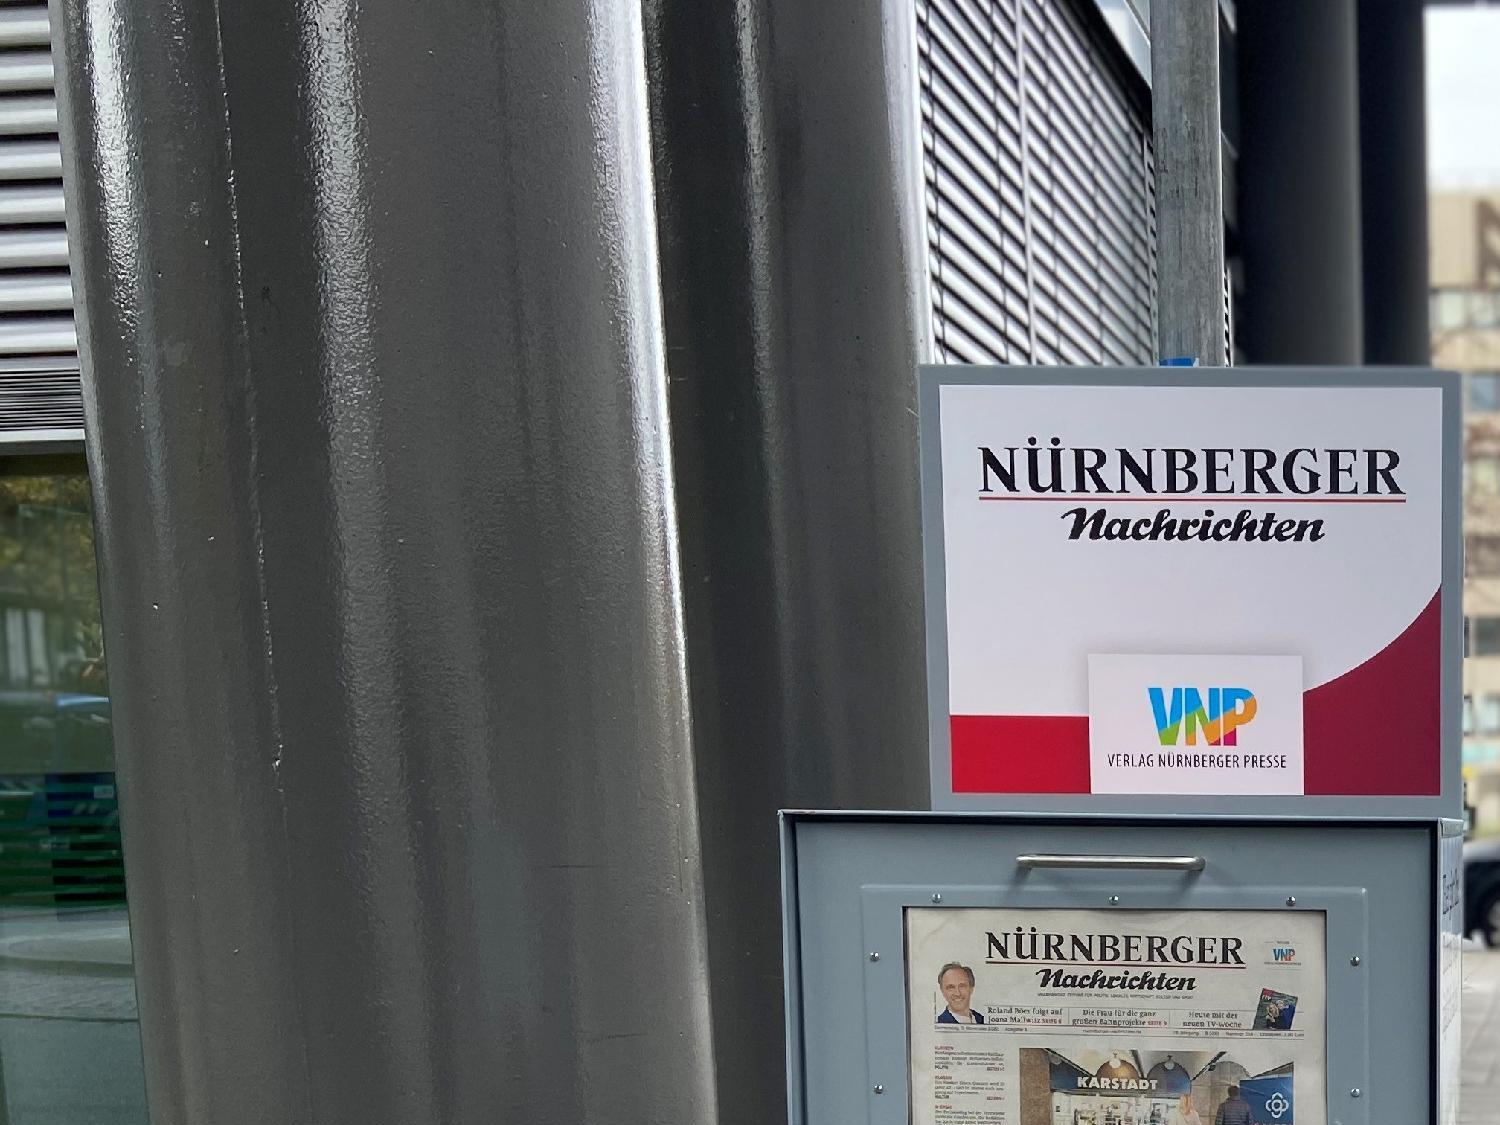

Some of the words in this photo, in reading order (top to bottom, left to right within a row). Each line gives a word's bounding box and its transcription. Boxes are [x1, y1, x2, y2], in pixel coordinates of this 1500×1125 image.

[977, 437, 1407, 496] NÜRNBERGER
[1060, 507, 1326, 543] Nachrichten
[1147, 686, 1258, 747] VNP
[1107, 753, 1155, 769] VERLAG
[1158, 751, 1241, 769] NÜRNBERGER
[1243, 754, 1287, 769] PRESSE
[984, 926, 1247, 966] NÜRNBERGER
[1272, 948, 1296, 962] VNP
[1034, 968, 1197, 992] Nachrichten
[1077, 1076, 1158, 1091] KARSTADT
